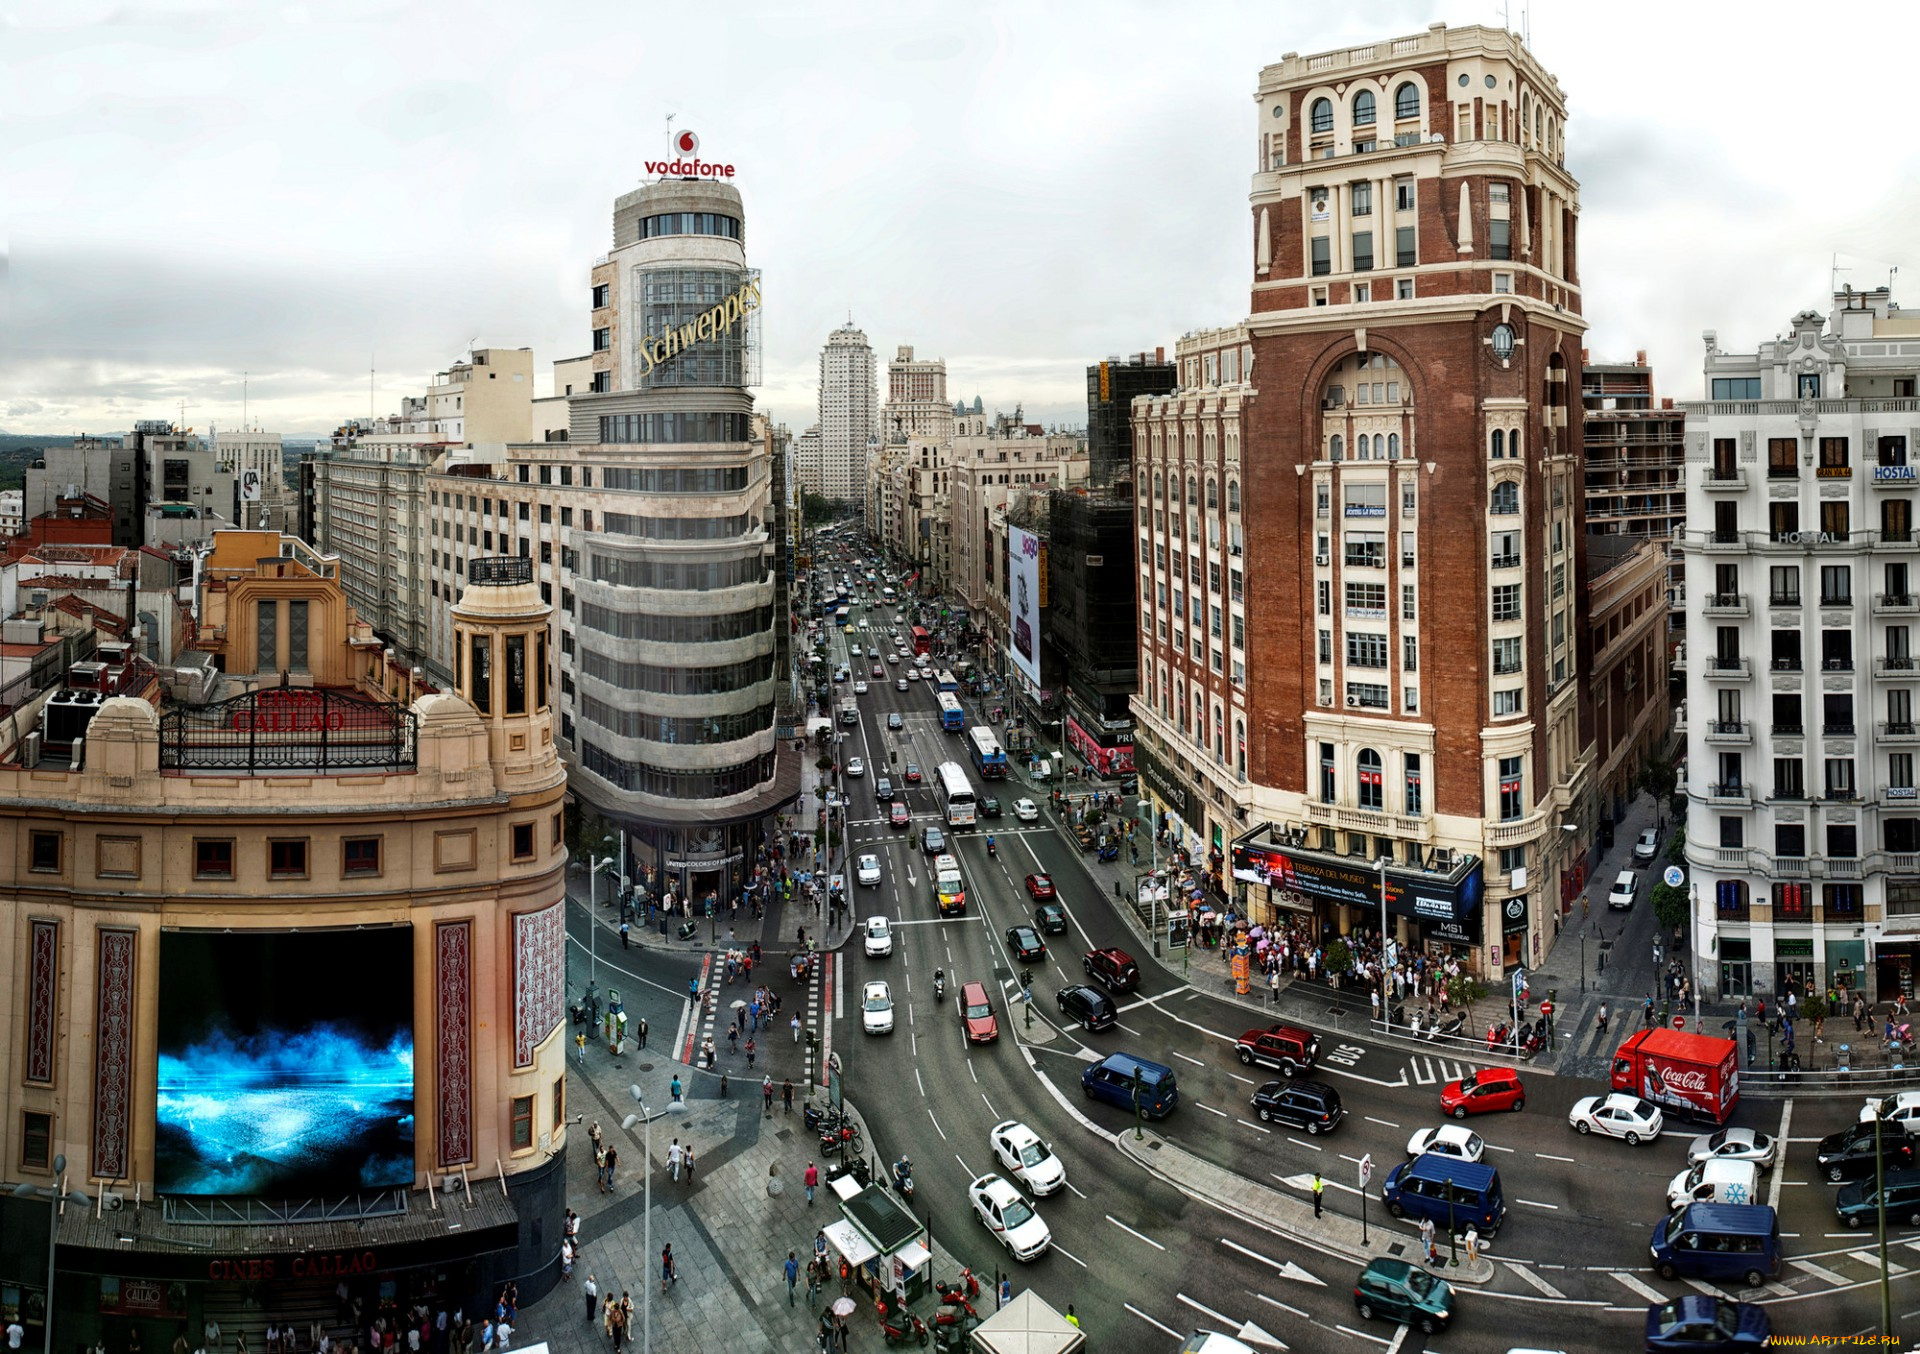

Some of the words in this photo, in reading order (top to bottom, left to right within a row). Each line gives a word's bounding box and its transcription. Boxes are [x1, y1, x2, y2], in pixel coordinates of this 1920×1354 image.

[645, 159, 735, 177] vodafone
[640, 277, 761, 377] Schweppes
[1874, 467, 1916, 478] HOSTAL
[1778, 532, 1839, 543] HOSTAL
[257, 690, 322, 707] CINES
[233, 710, 344, 732] CALLAO
[720, 853, 744, 865] BENETTON
[1295, 863, 1325, 876] TERRAZA
[1326, 870, 1338, 879] DEL
[1340, 874, 1365, 884] MUSEO
[1441, 923, 1463, 934] MS1
[1326, 1044, 1366, 1066] BUS
[1661, 1066, 1707, 1091] Coca-Cola
[209, 1259, 275, 1280] CINES
[292, 1252, 377, 1277] CALLAO
[125, 1288, 161, 1302] CALLAO
